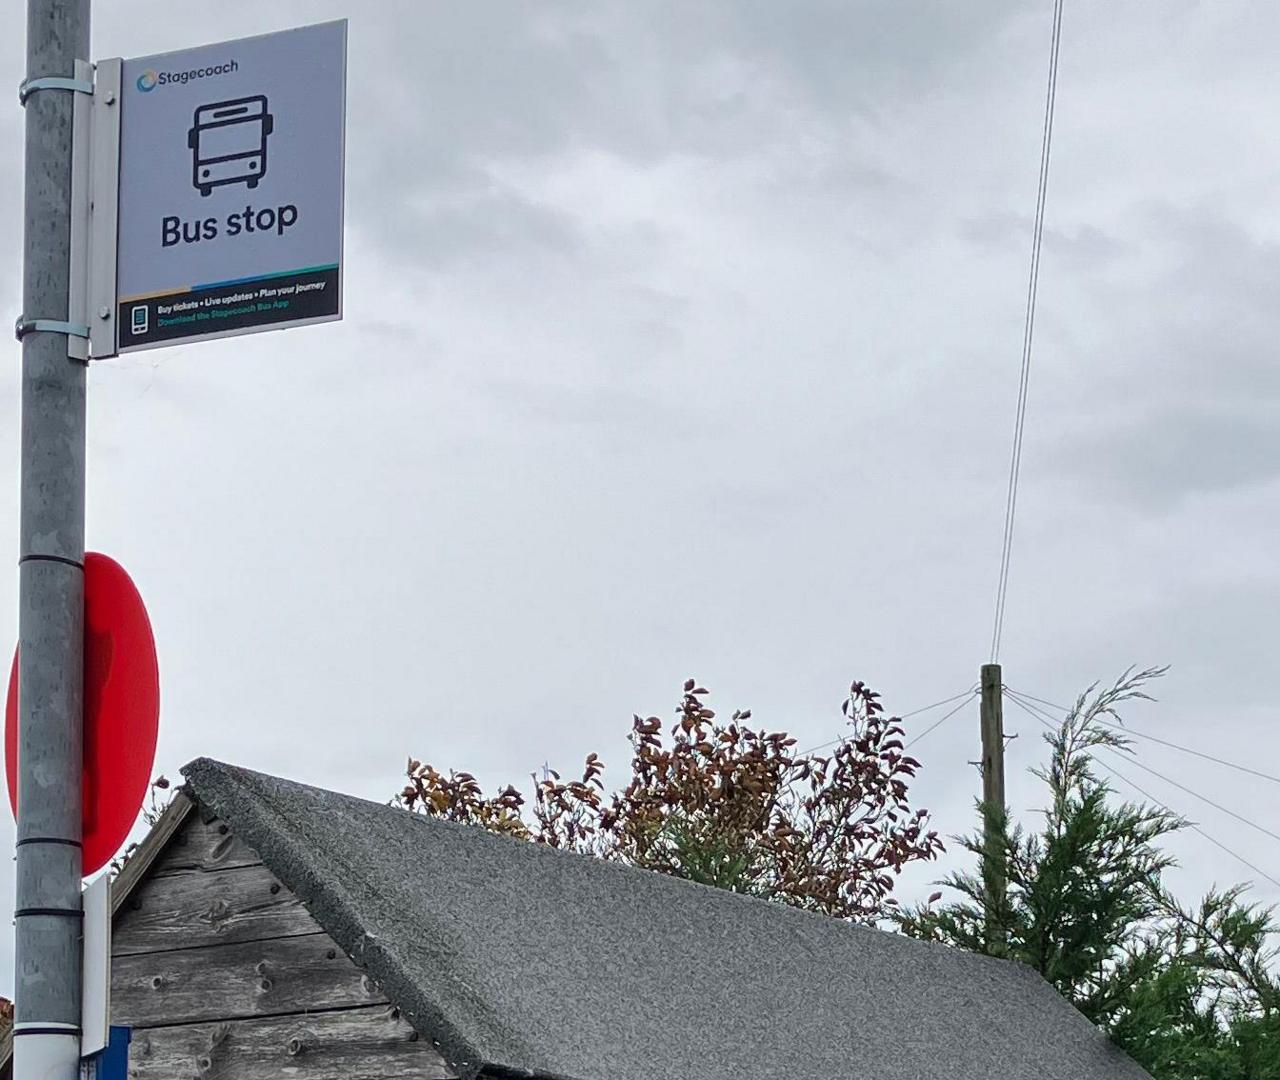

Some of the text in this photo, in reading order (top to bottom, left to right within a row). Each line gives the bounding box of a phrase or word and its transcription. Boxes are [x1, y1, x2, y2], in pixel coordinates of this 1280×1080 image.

[158, 59, 238, 85] Stagecoach
[161, 204, 298, 247] Bus stop
[157, 281, 326, 315] Buy tickets Live updates Plan your journey
[272, 300, 289, 309] App
